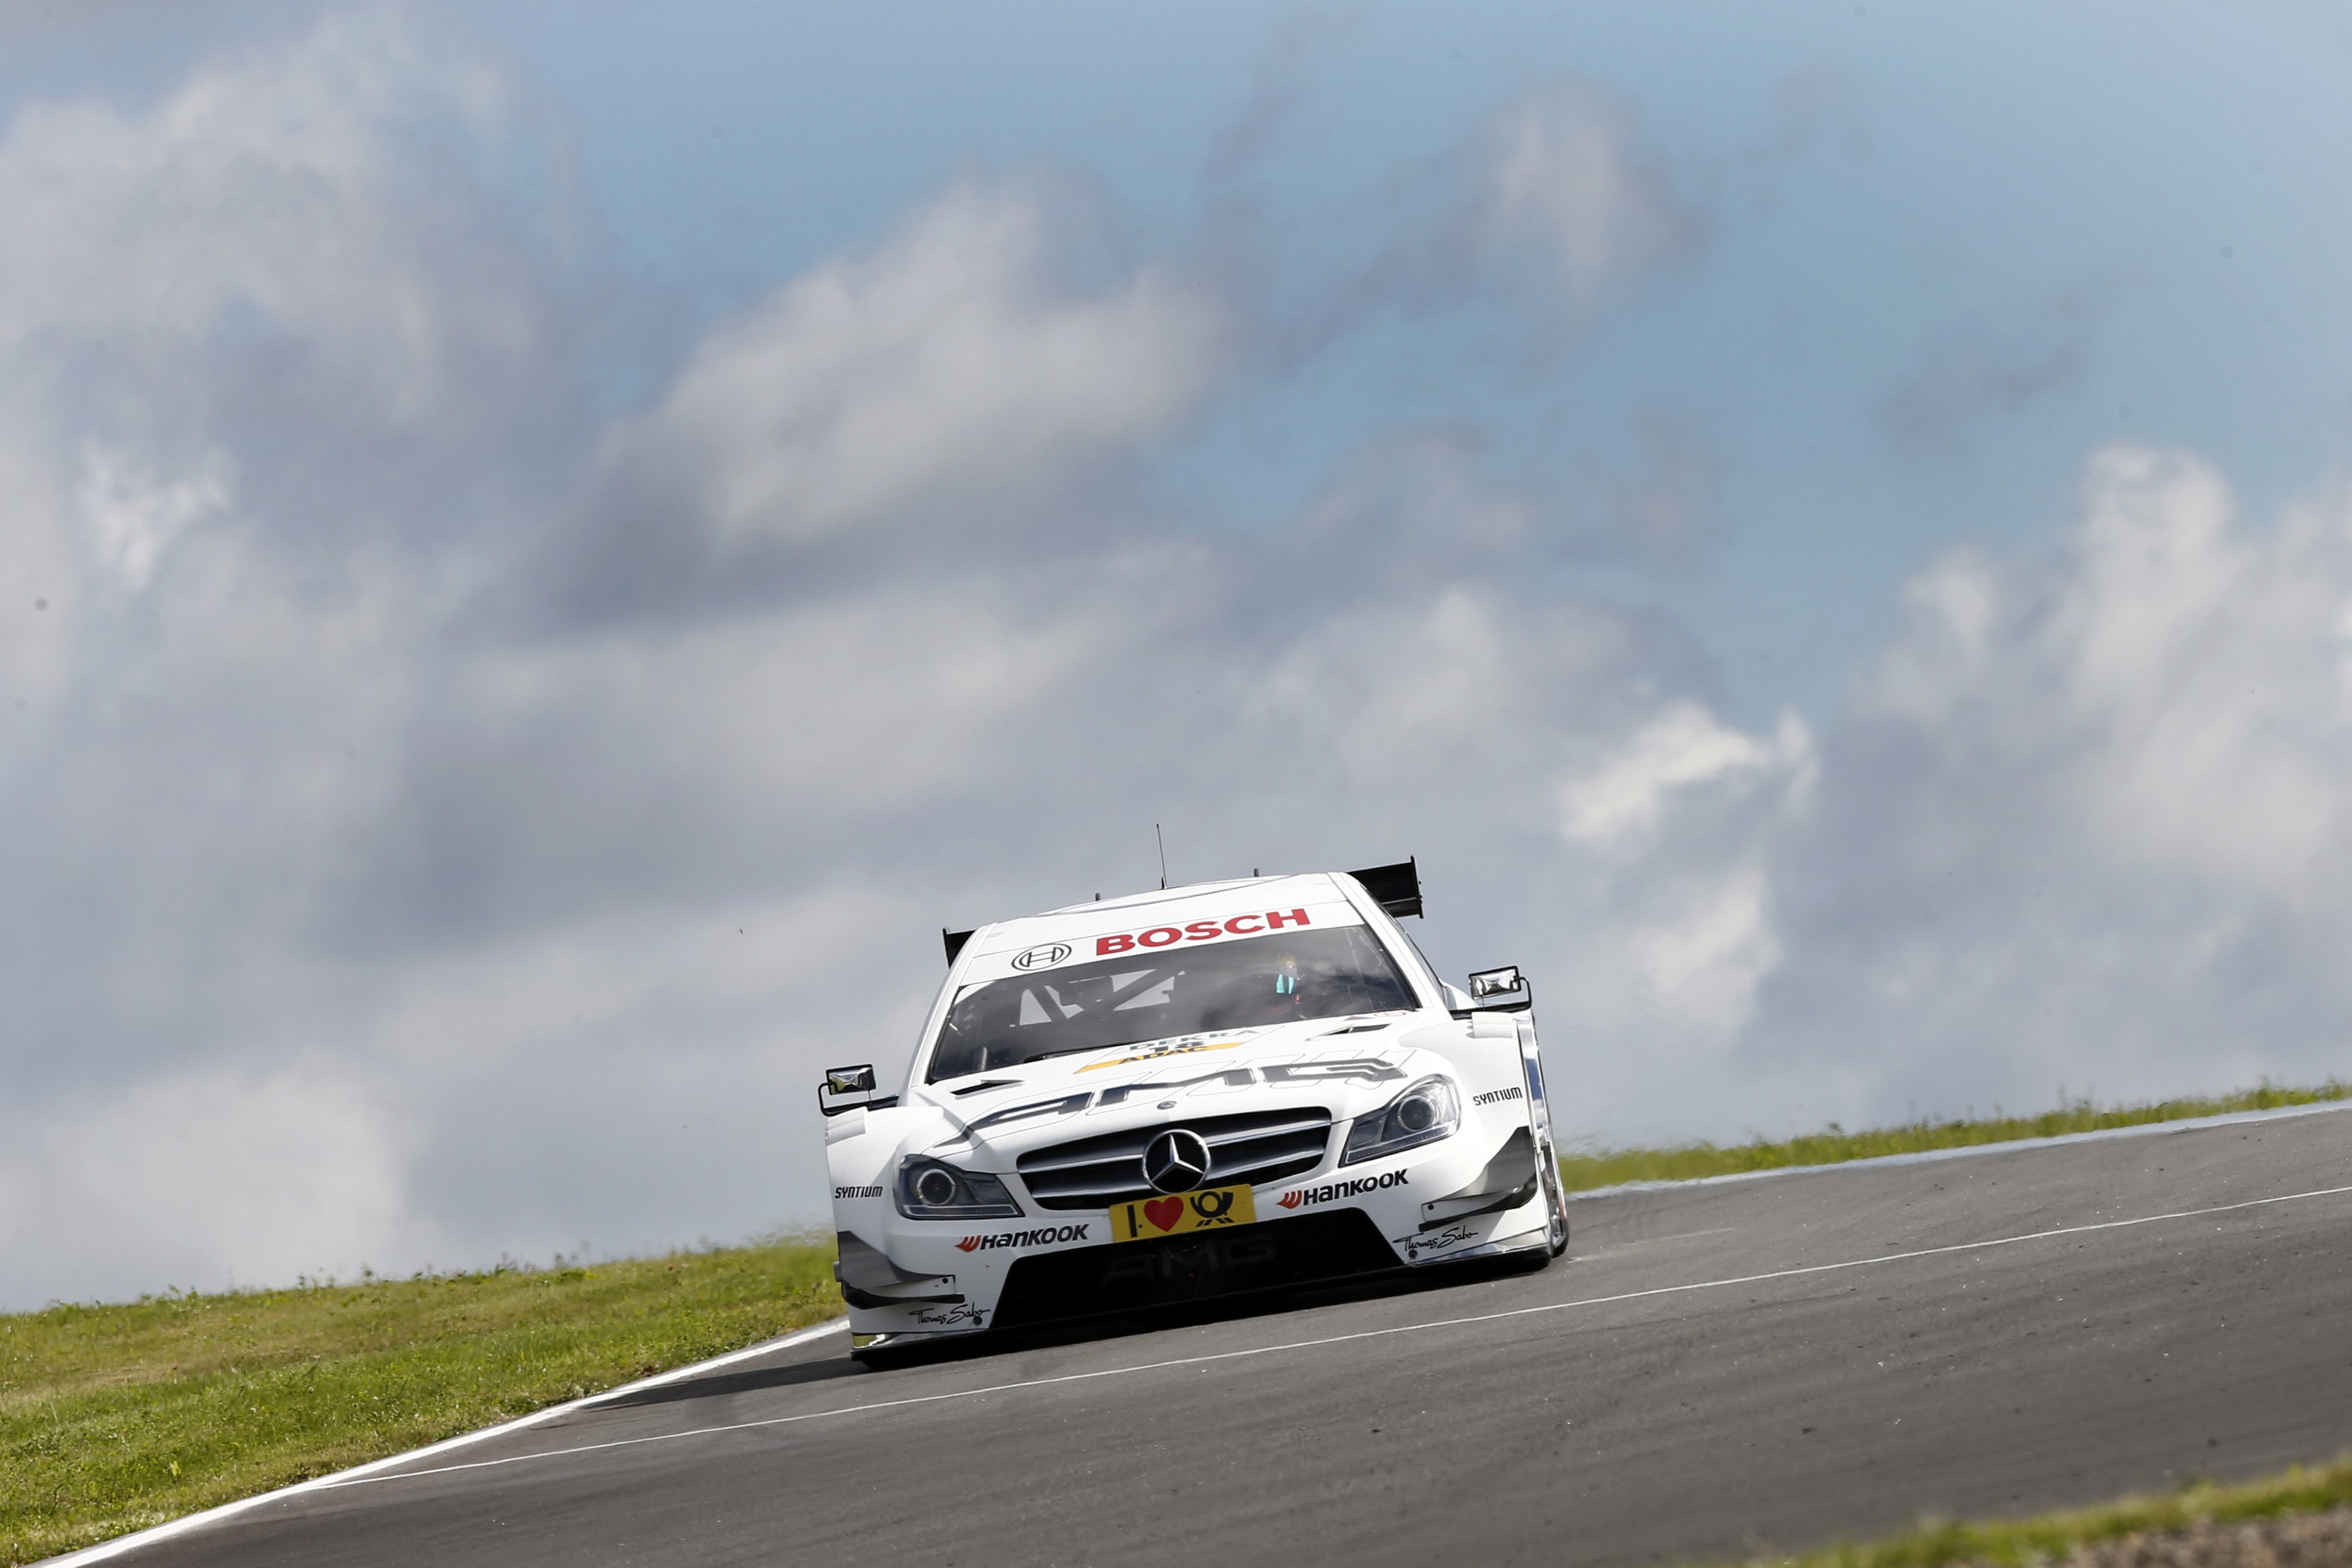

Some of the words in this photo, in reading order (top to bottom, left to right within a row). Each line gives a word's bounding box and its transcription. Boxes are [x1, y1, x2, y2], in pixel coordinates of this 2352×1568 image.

[1095, 909, 1311, 956] BOSCH
[1117, 1047, 1208, 1064] ADAC
[1473, 1086, 1523, 1106] SYNTIUM
[834, 1185, 883, 1198] SYNTIUM
[1393, 1233, 1438, 1252] Thomas
[1437, 1226, 1478, 1248] Sabo
[908, 1308, 947, 1325] Thomas
[946, 1302, 991, 1323] Sabo
